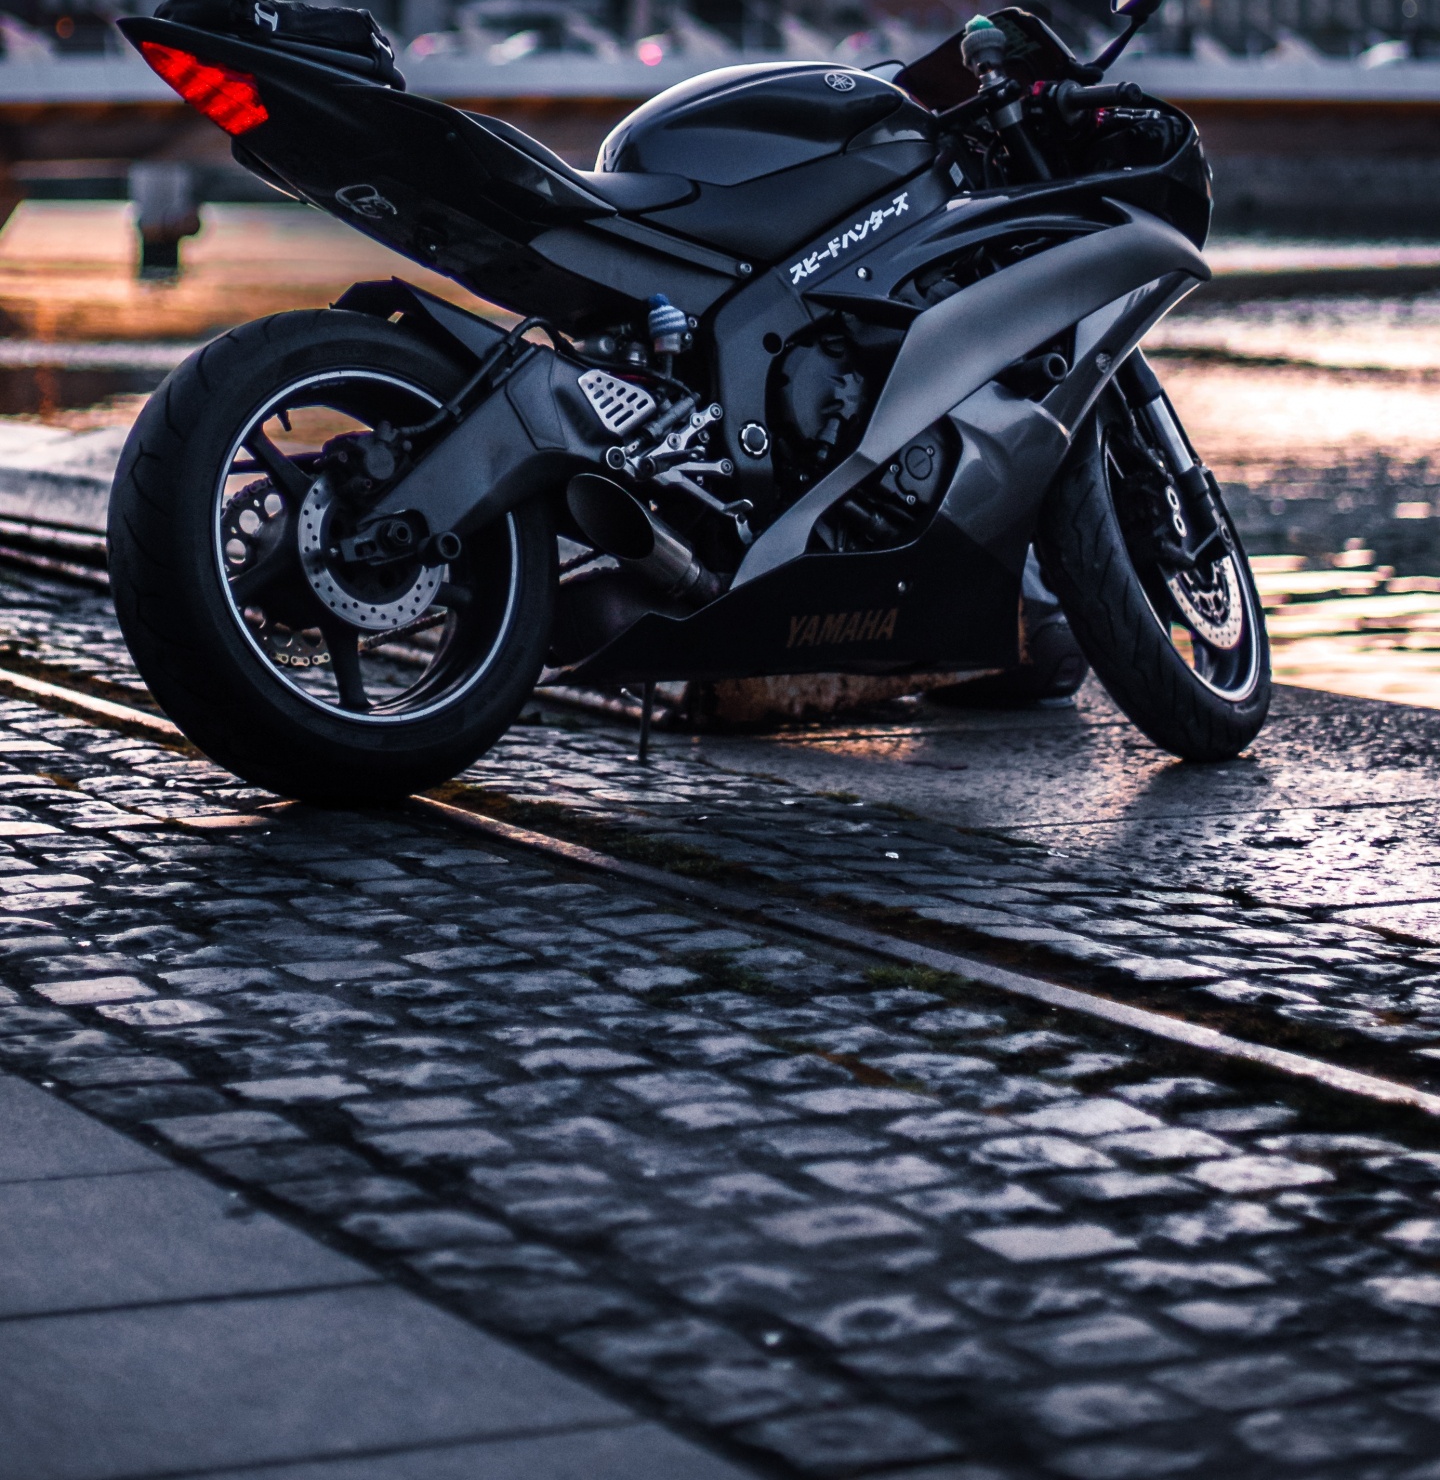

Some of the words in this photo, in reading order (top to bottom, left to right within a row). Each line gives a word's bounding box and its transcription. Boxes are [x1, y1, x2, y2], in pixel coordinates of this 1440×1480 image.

[789, 191, 909, 285] スピードハンターズ
[785, 607, 899, 649] YAMAHA
